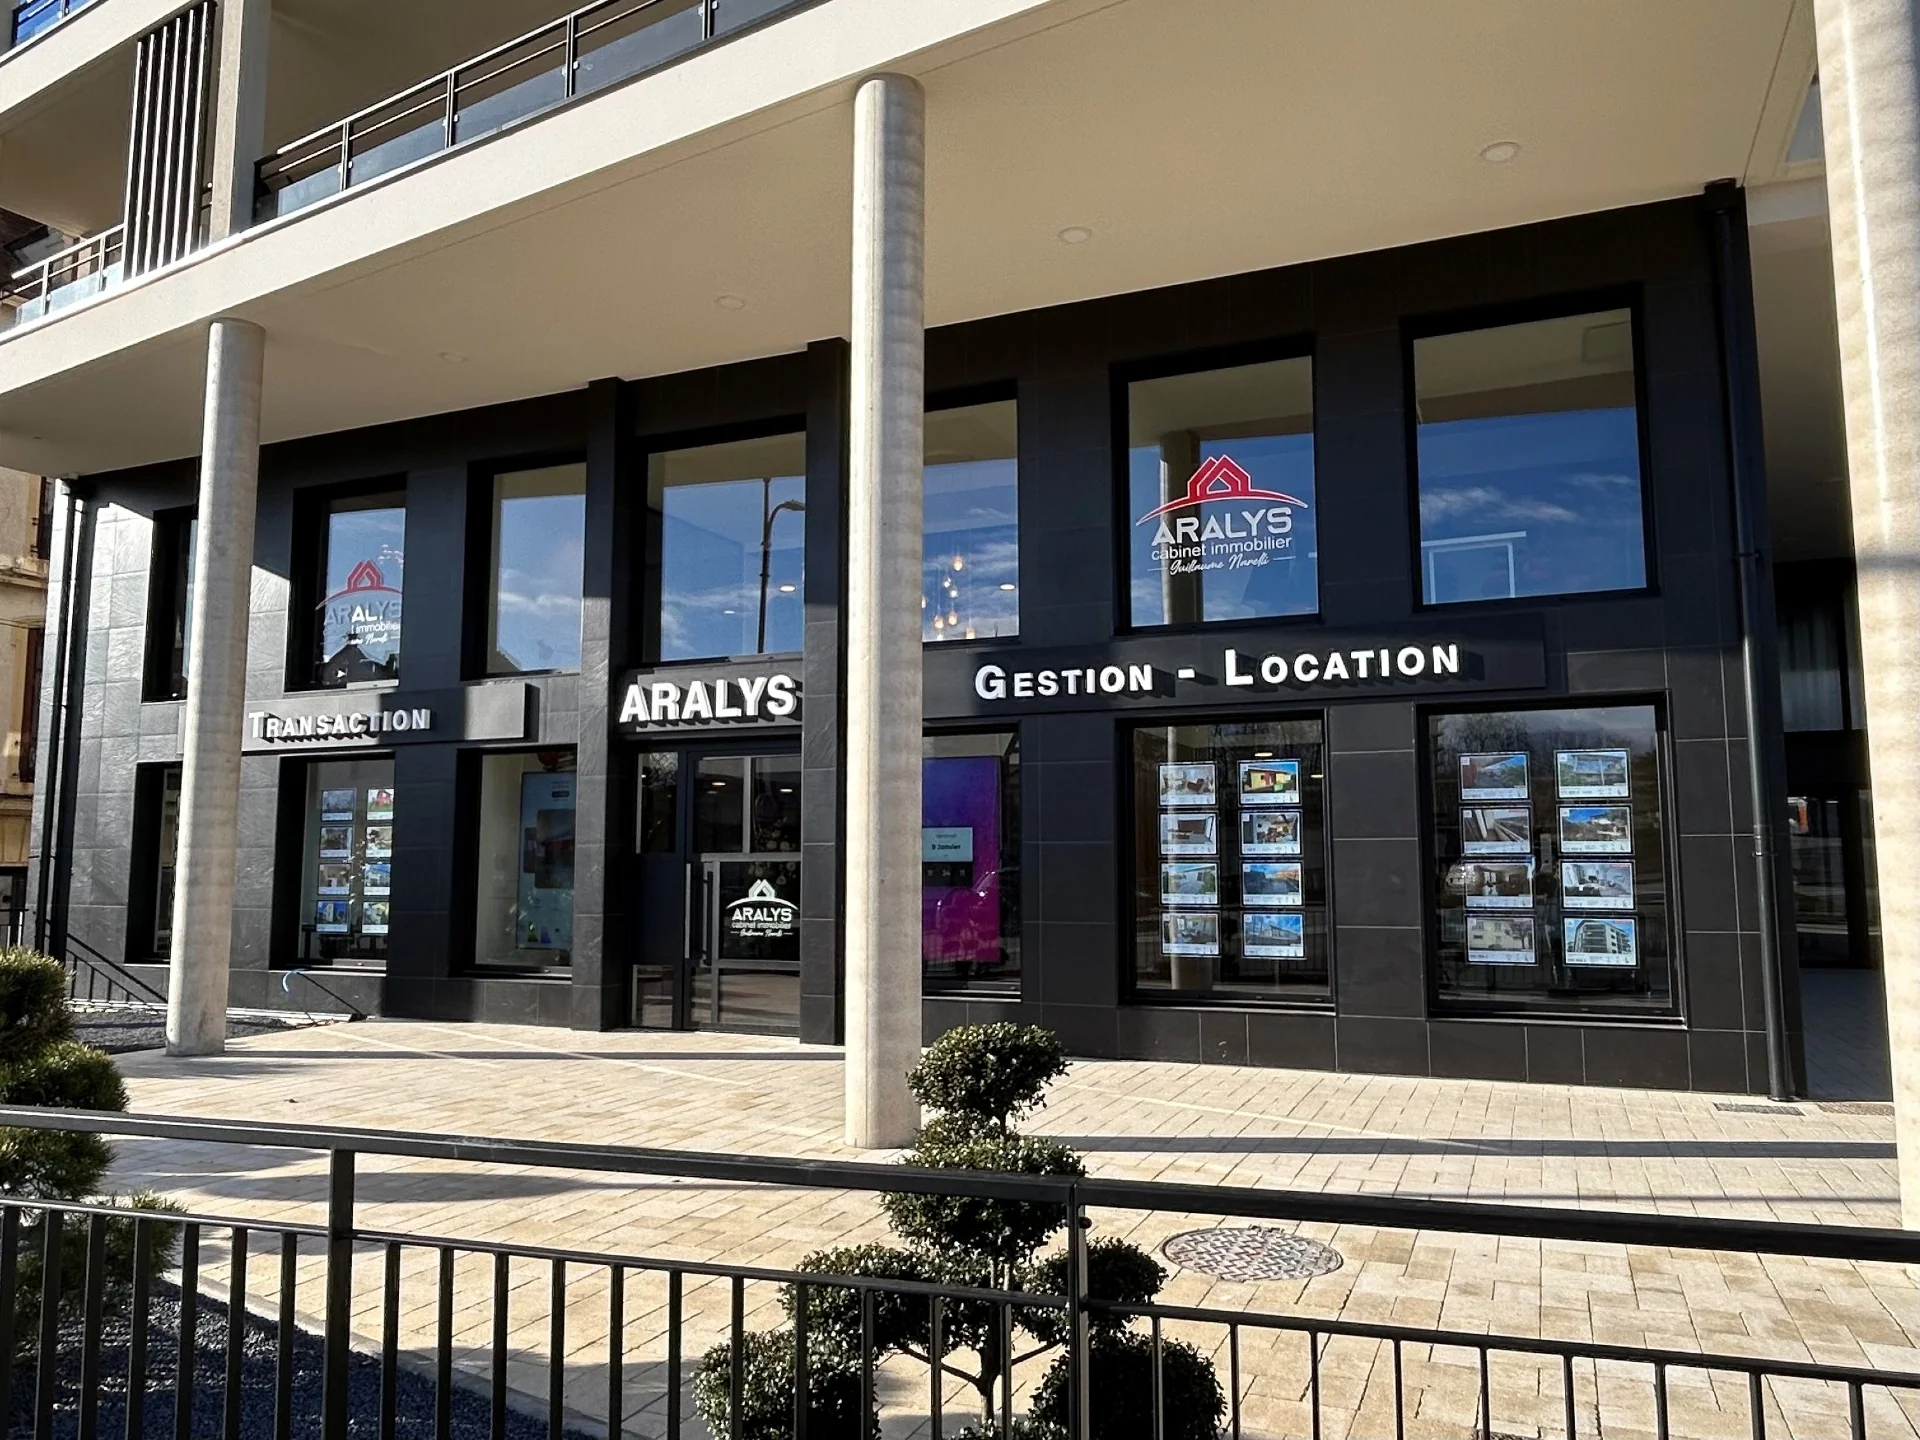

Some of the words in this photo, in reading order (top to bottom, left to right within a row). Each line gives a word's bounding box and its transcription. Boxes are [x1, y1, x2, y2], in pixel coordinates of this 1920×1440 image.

[1151, 506, 1292, 547] ARALYS
[1151, 546, 1207, 560] cabinet
[1211, 536, 1292, 556] immobilier
[975, 664, 1153, 700] GESTION
[1225, 643, 1459, 686] LOCATION
[619, 674, 798, 723] ARALYS
[249, 709, 431, 739] TRANSACTION
[731, 907, 792, 922] ARALYS
